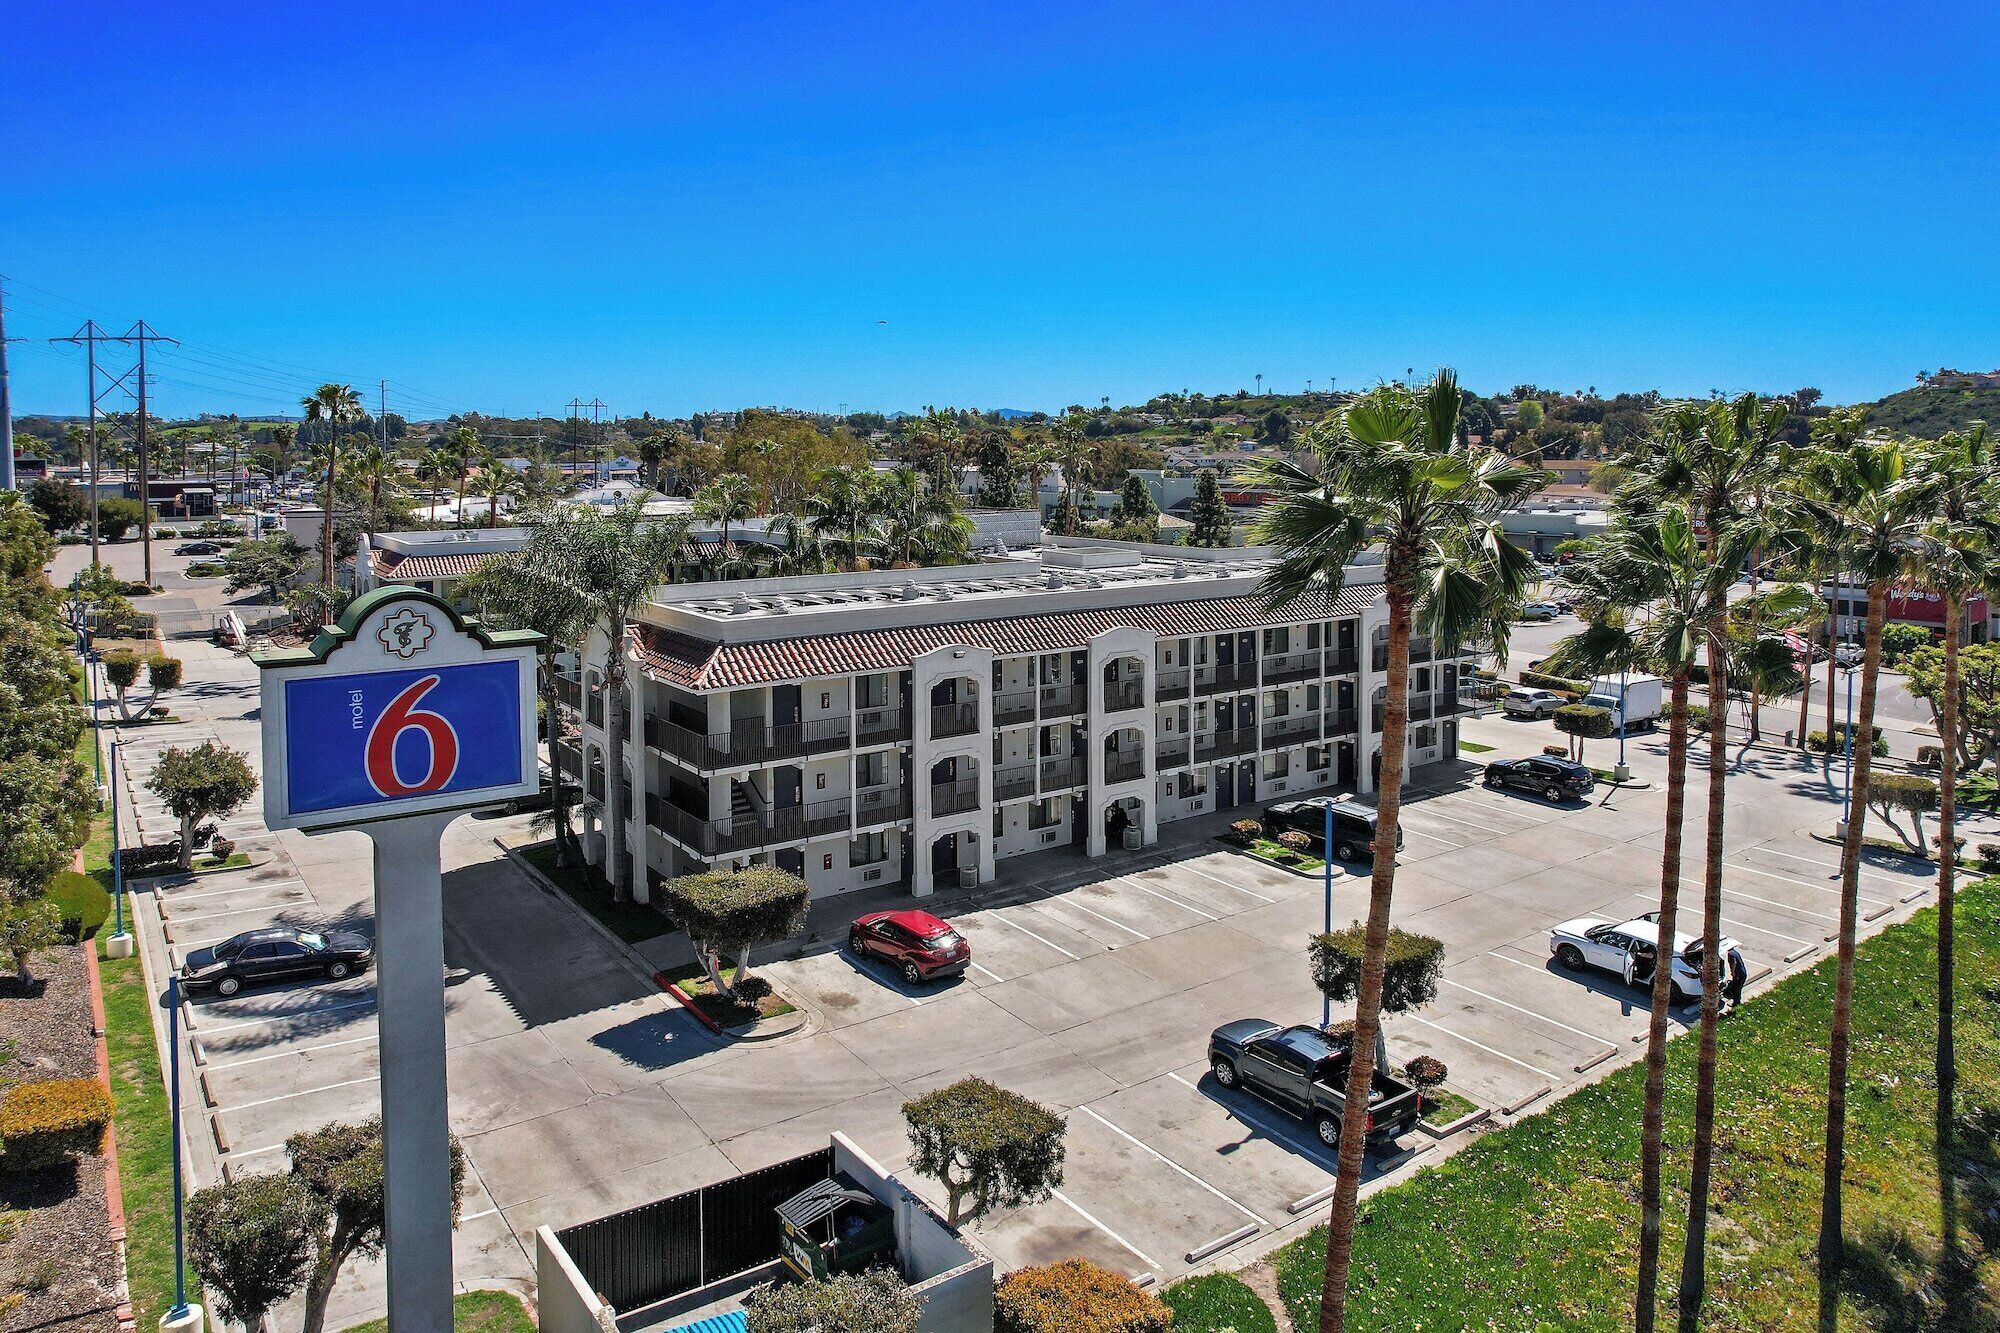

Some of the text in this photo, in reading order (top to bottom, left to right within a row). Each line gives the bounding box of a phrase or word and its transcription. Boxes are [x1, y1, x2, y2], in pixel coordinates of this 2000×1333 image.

[1890, 589, 1925, 601] Wedy's
[348, 689, 363, 729] motel
[364, 674, 460, 798] 6
